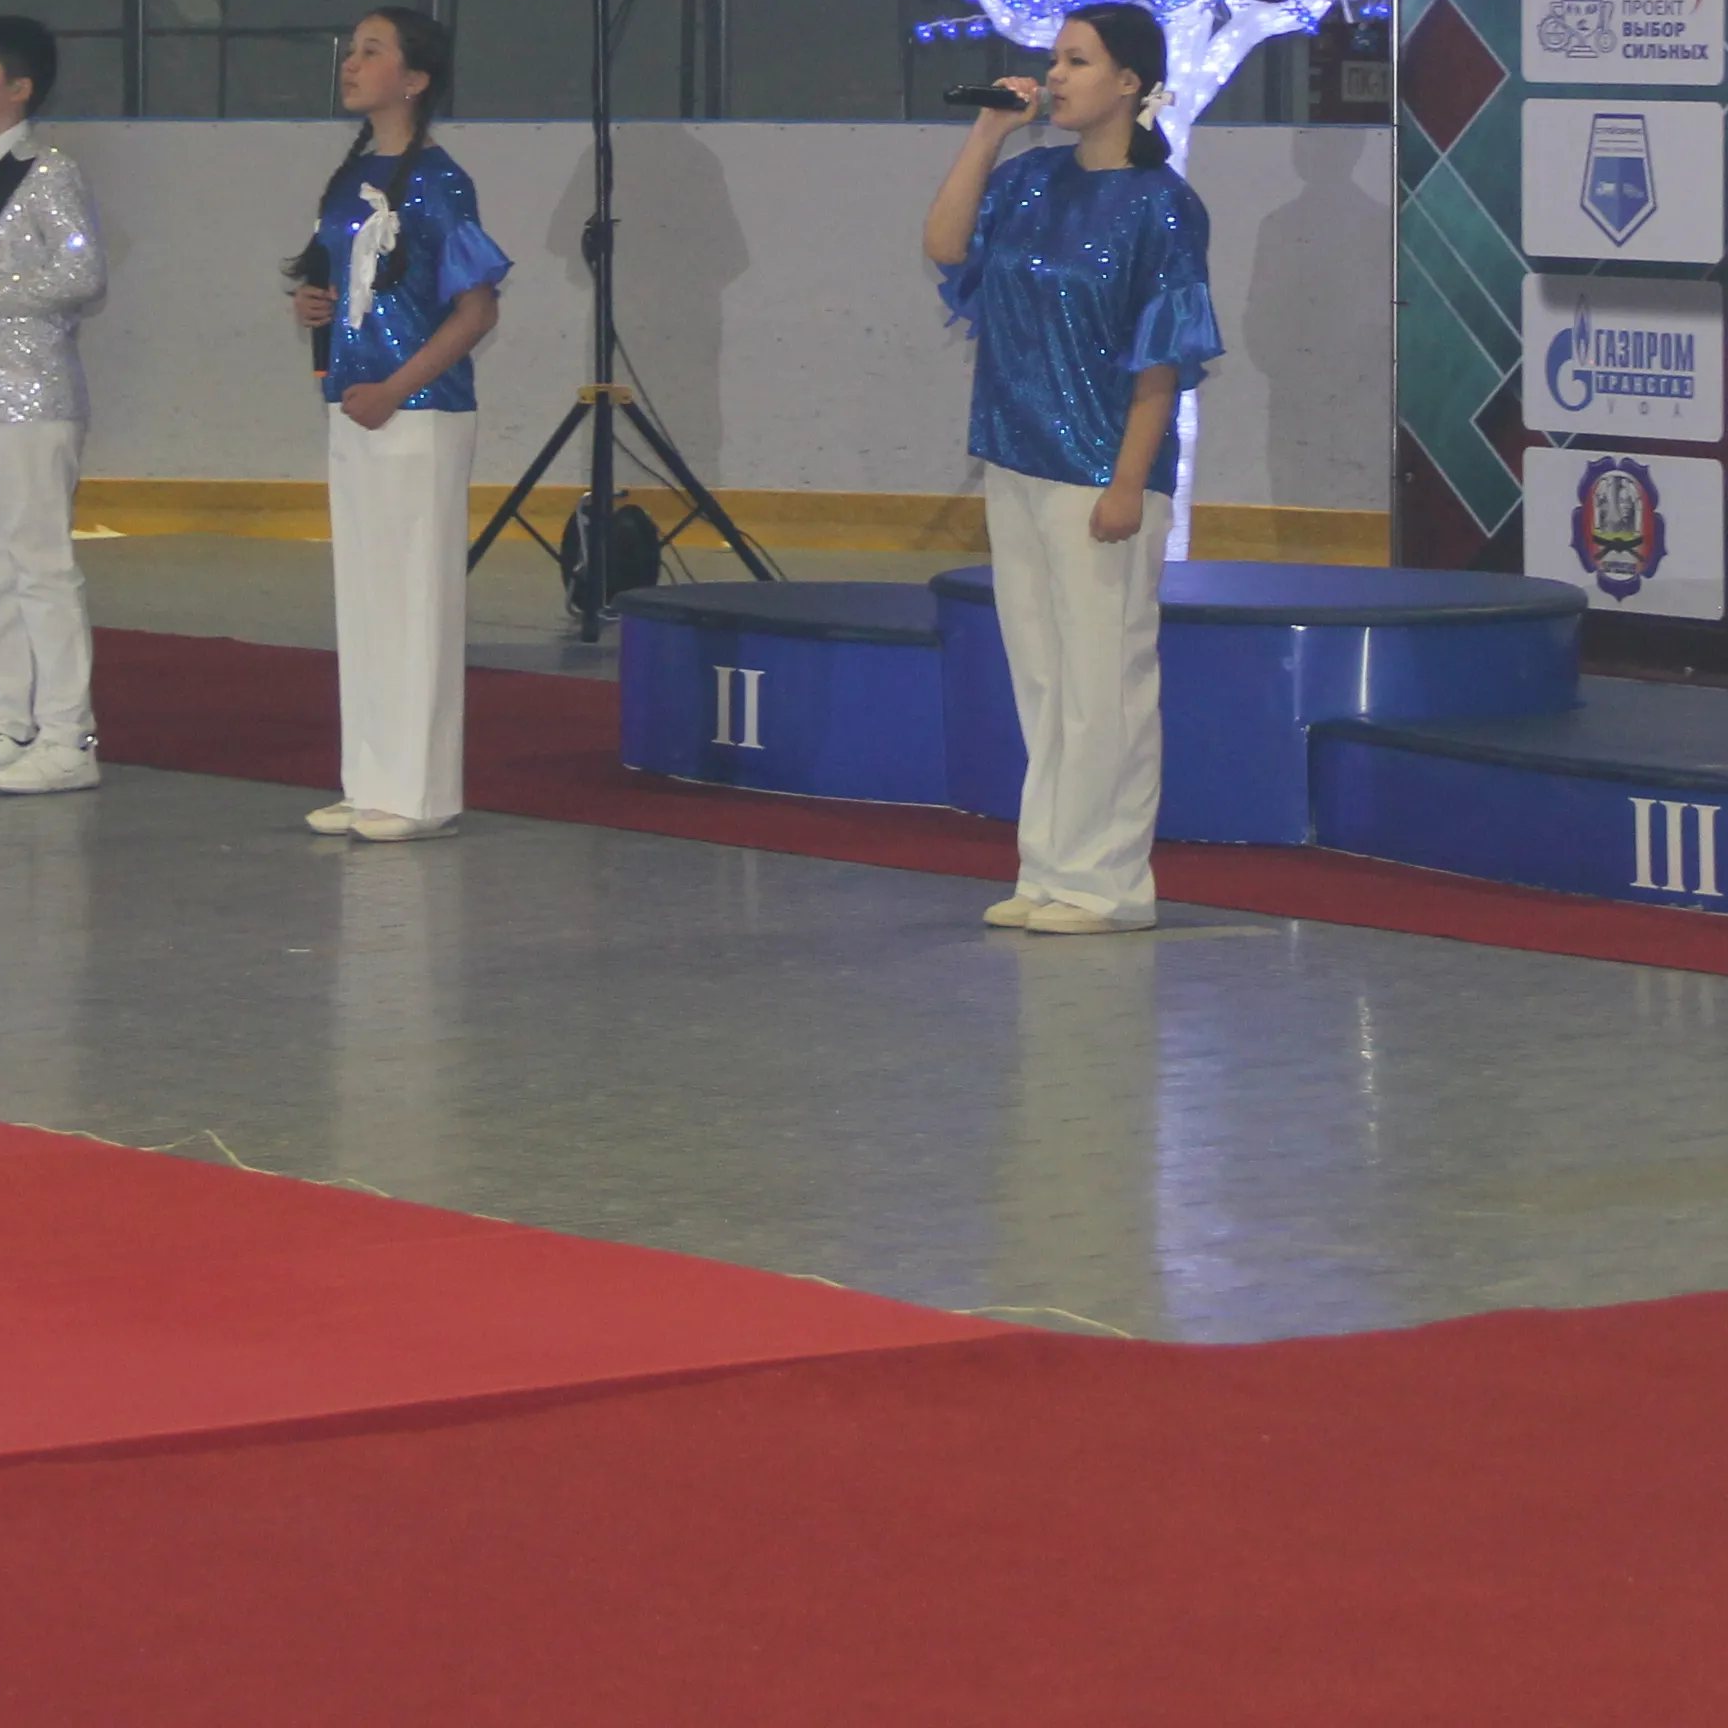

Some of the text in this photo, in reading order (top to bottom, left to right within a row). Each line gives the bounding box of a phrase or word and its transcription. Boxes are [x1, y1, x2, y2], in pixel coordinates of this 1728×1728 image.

[1622, 0, 1685, 17] ПРОЕКТ
[1622, 20, 1686, 39] ВЫБОР
[1622, 42, 1709, 61] СИЛЬНЫХ
[1594, 328, 1695, 372] ГАЗПРОМ
[711, 665, 766, 750] II
[1627, 796, 1725, 897] III
